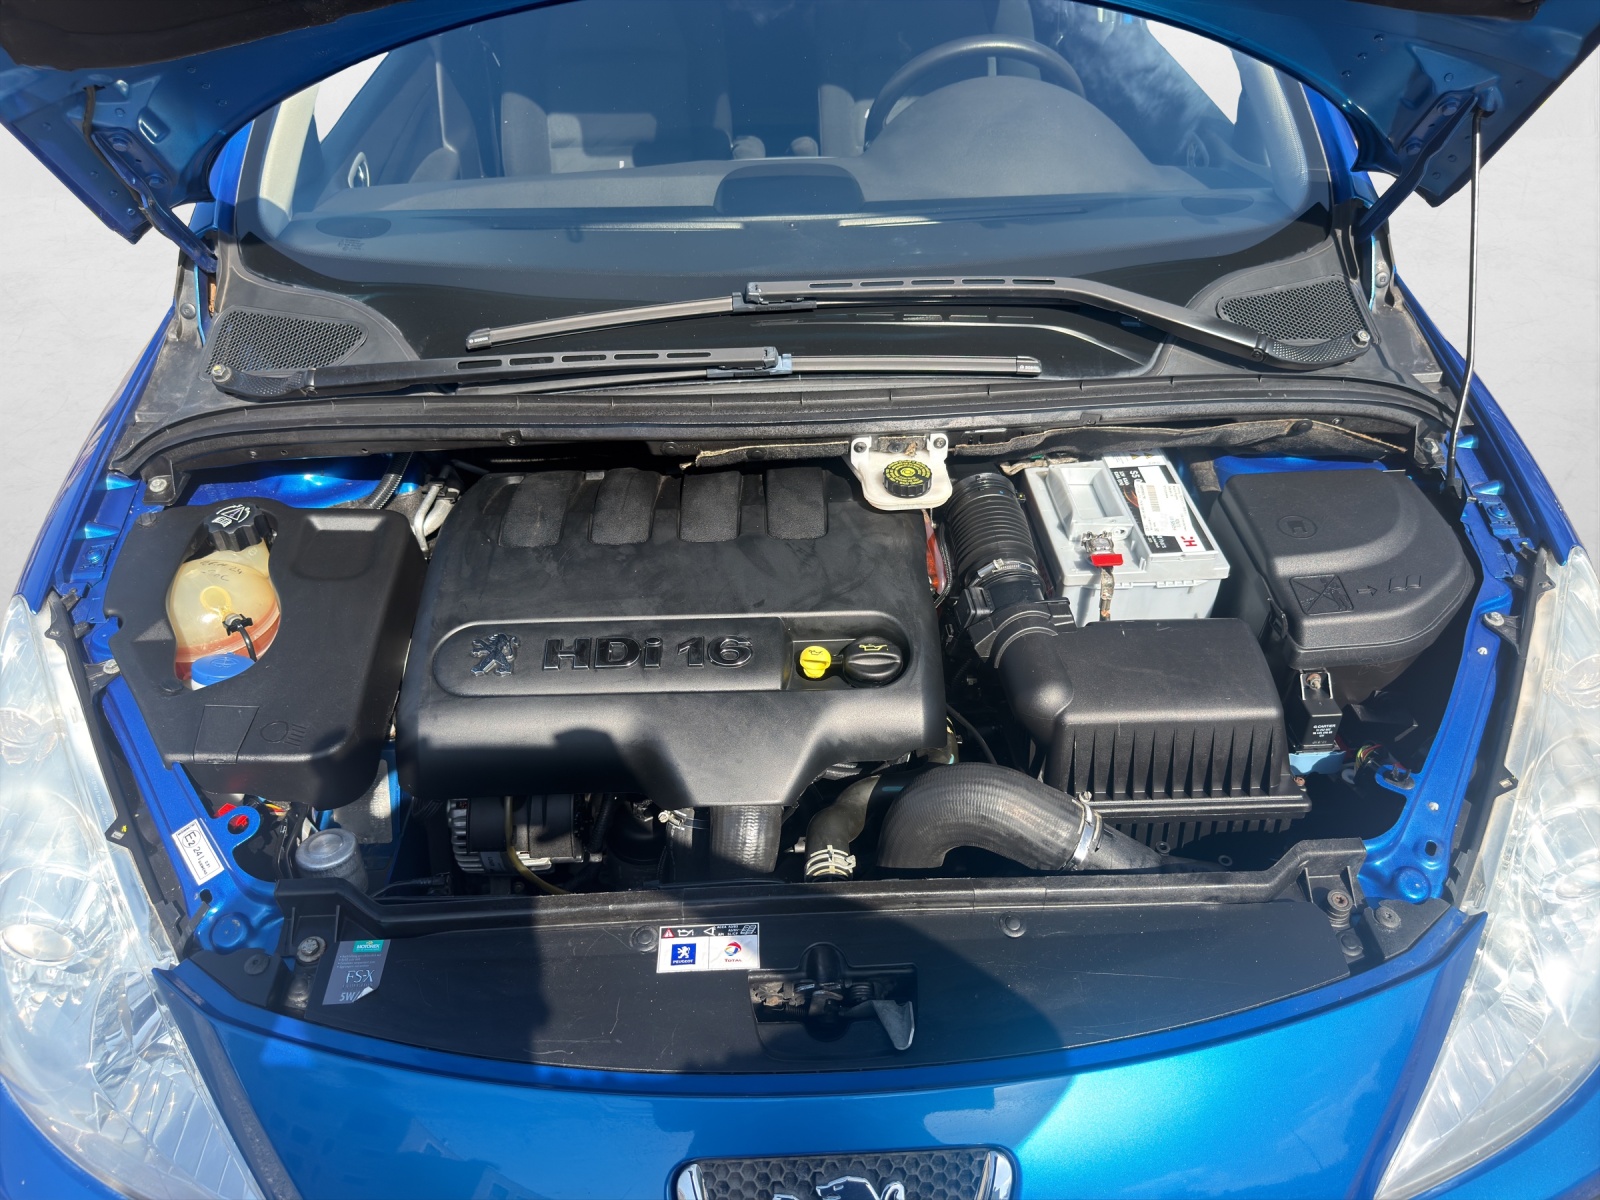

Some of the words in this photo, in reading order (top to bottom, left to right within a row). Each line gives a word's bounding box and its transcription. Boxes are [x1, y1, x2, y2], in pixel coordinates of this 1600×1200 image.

[542, 636, 664, 671] HDi
[677, 635, 753, 668] 16
[345, 969, 375, 984] FS-X
[339, 991, 361, 1003] 5W/
